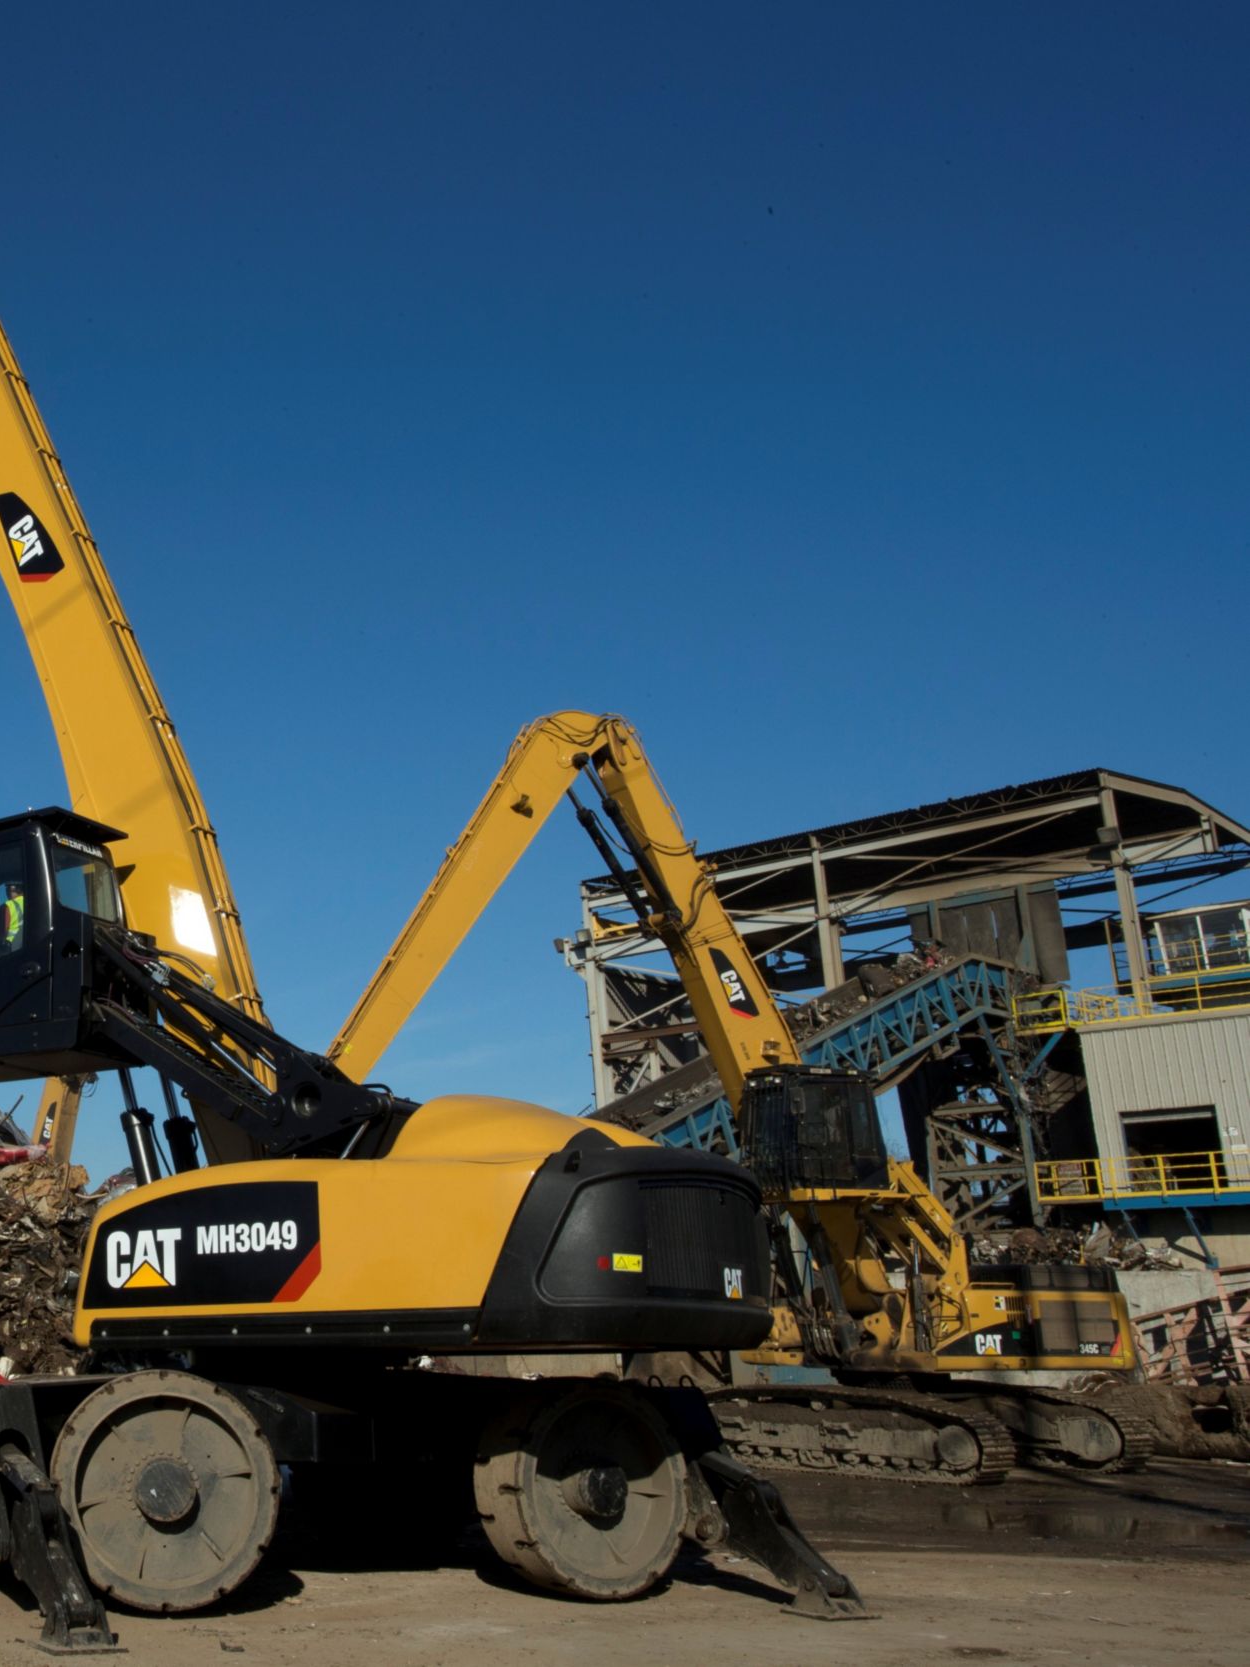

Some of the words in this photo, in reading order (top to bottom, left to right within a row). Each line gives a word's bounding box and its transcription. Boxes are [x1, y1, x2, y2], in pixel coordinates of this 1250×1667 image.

[8, 514, 44, 567] CAT
[720, 970, 745, 1002] CAT
[43, 1116, 54, 1139] CAT
[106, 1228, 182, 1289] CAT
[196, 1219, 298, 1255] MH3049
[723, 1267, 743, 1299] CAT
[975, 1334, 1002, 1355] CAT
